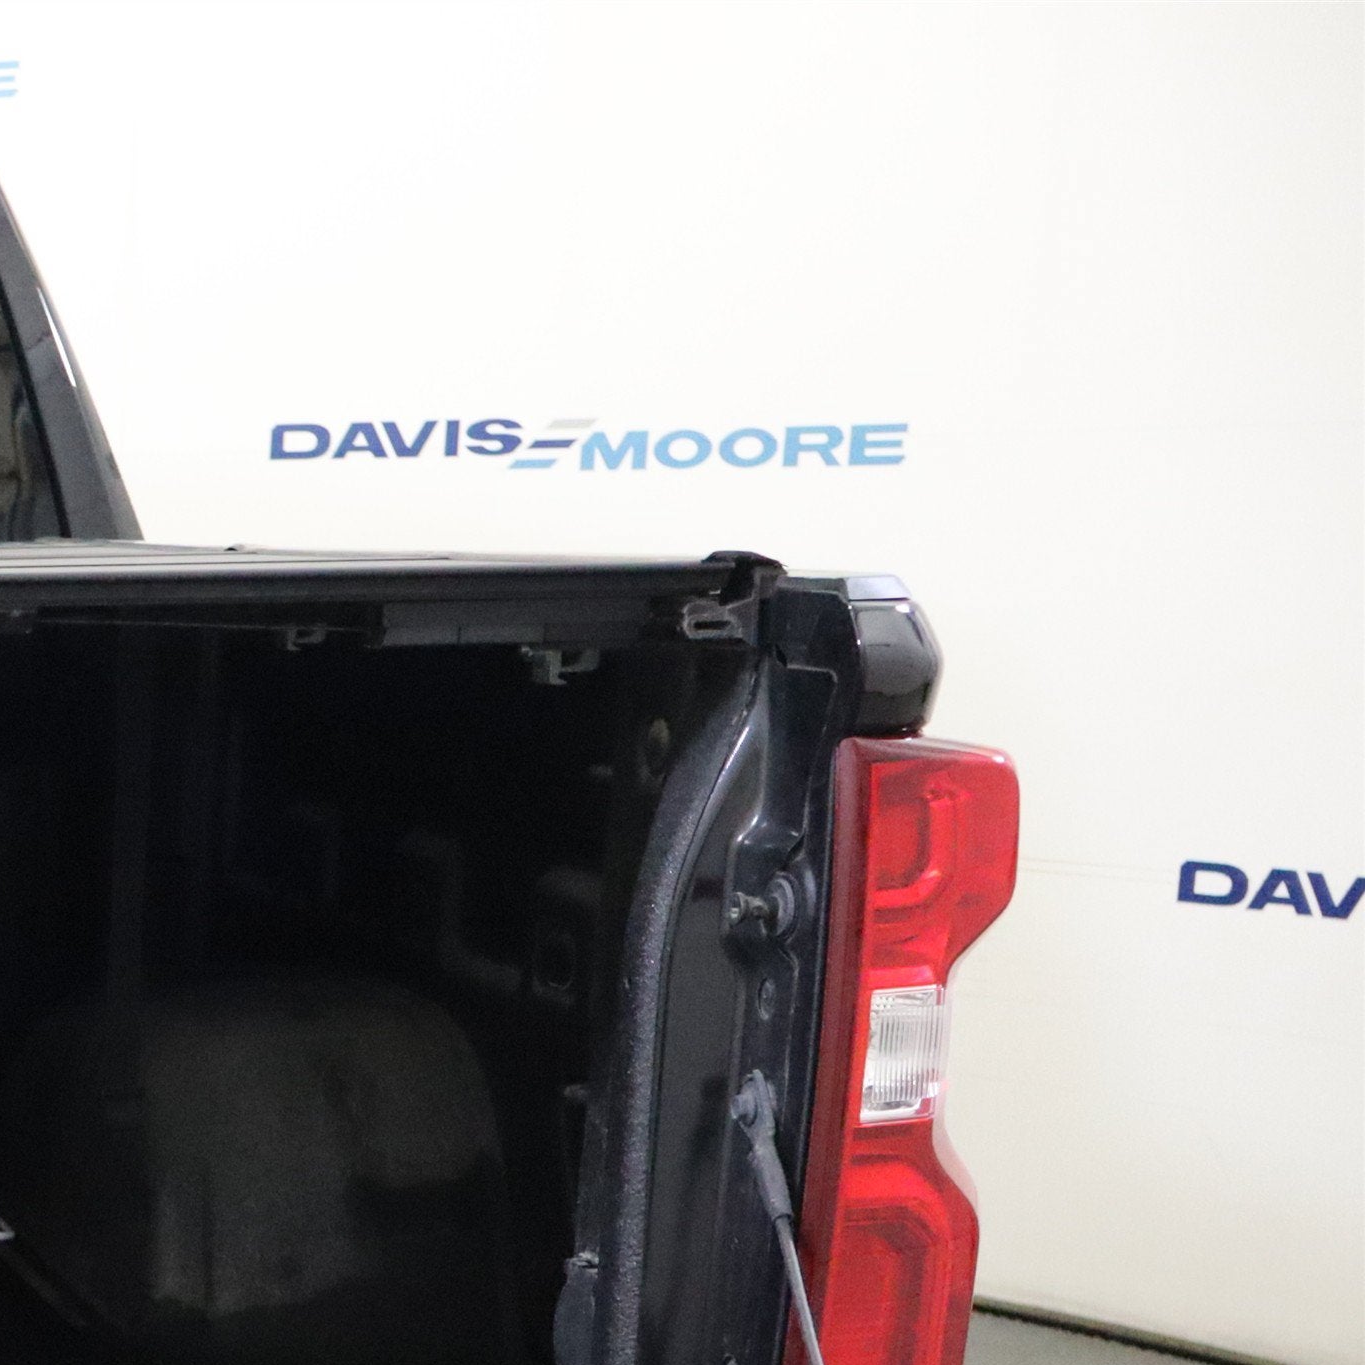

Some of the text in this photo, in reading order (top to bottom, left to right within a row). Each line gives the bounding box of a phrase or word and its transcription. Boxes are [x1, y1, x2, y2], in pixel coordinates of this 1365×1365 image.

[269, 418, 909, 471] DAVIS MOORE
[1177, 860, 1365, 919] DAV
